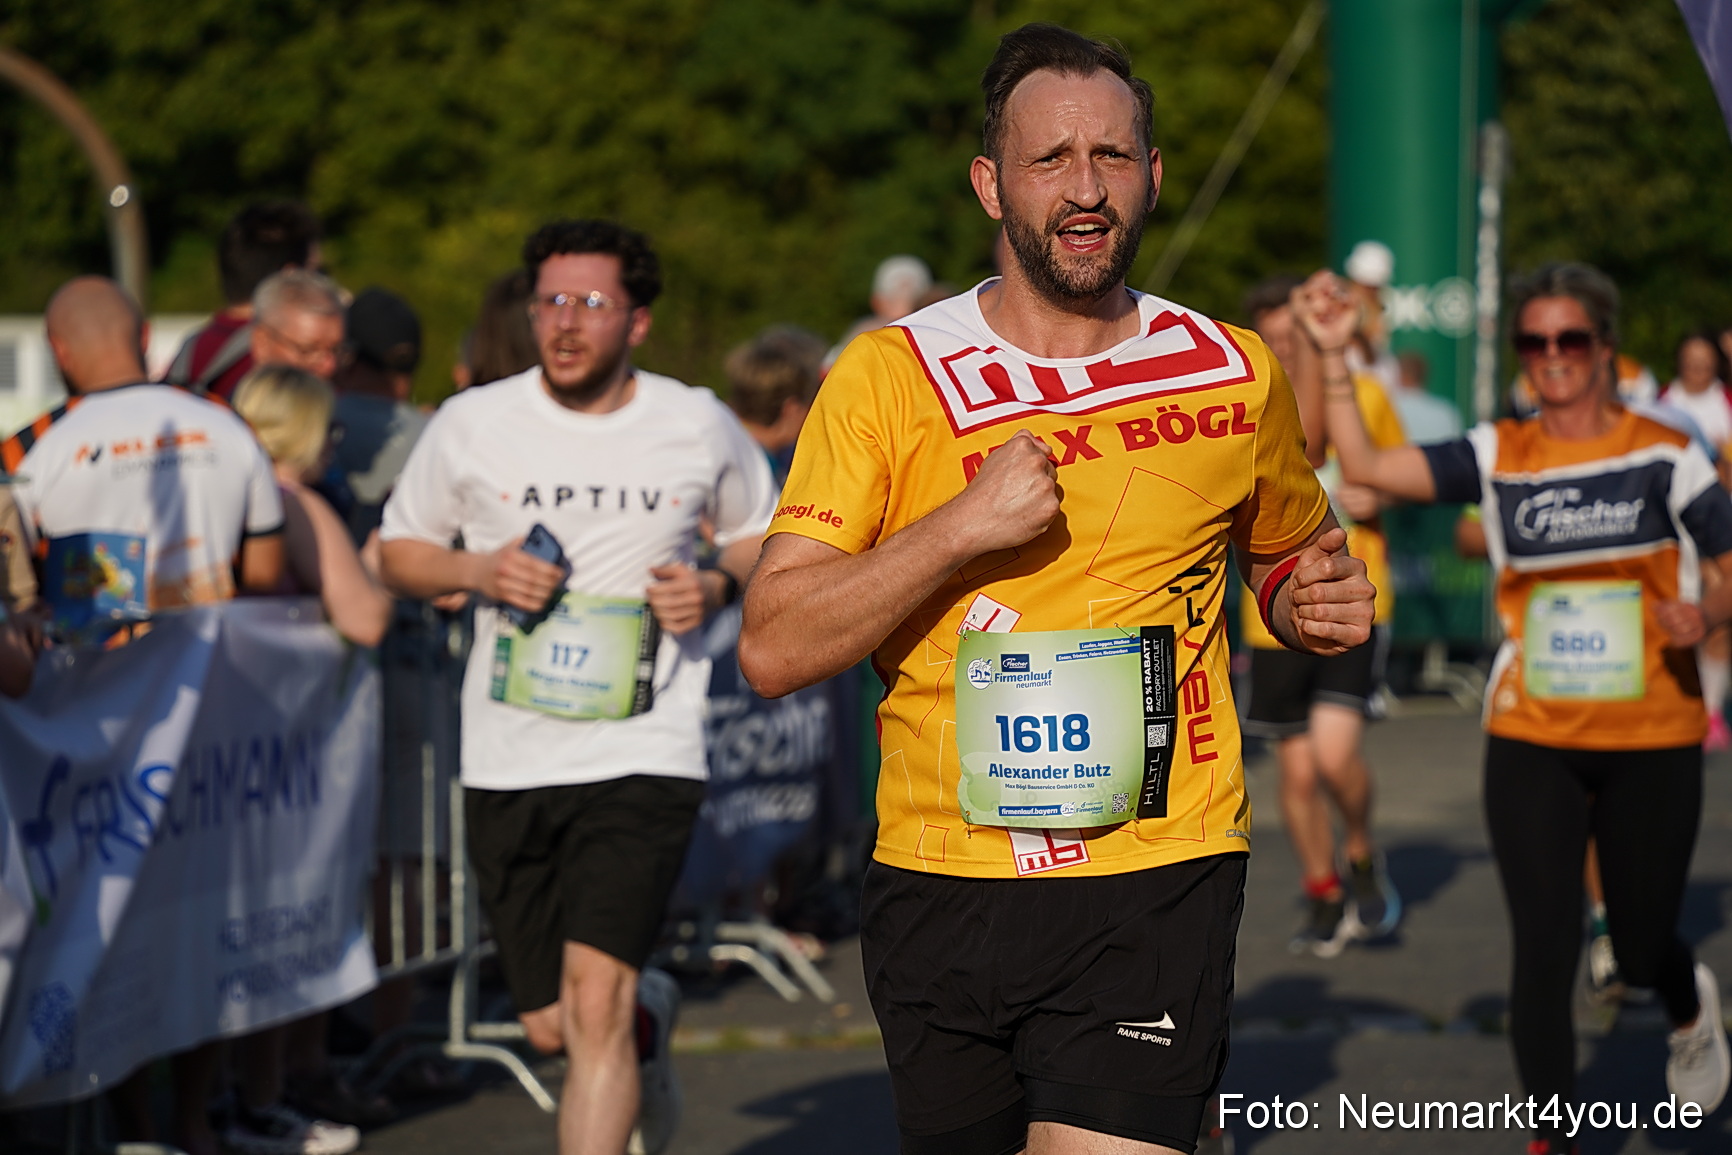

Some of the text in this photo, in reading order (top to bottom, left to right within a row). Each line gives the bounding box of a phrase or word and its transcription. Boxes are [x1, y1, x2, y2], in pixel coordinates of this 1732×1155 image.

[1115, 402, 1255, 452] BÖGL
[522, 486, 661, 511] APTIV
[552, 642, 590, 669] 117
[994, 670, 1052, 682] Firmenlauf
[1016, 679, 1052, 688] neumarkt
[1143, 638, 1154, 713] 20 % RABATT
[1153, 639, 1162, 712] FACTORY OUTLET
[995, 713, 1091, 753] 1618
[988, 763, 1112, 780] Alexander Butz
[1143, 752, 1161, 805] HILTL
[1016, 783, 1027, 791] Bögl
[1001, 807, 1059, 816] firmenlauf.bayern
[1117, 1027, 1172, 1047] RANE SPORTS
